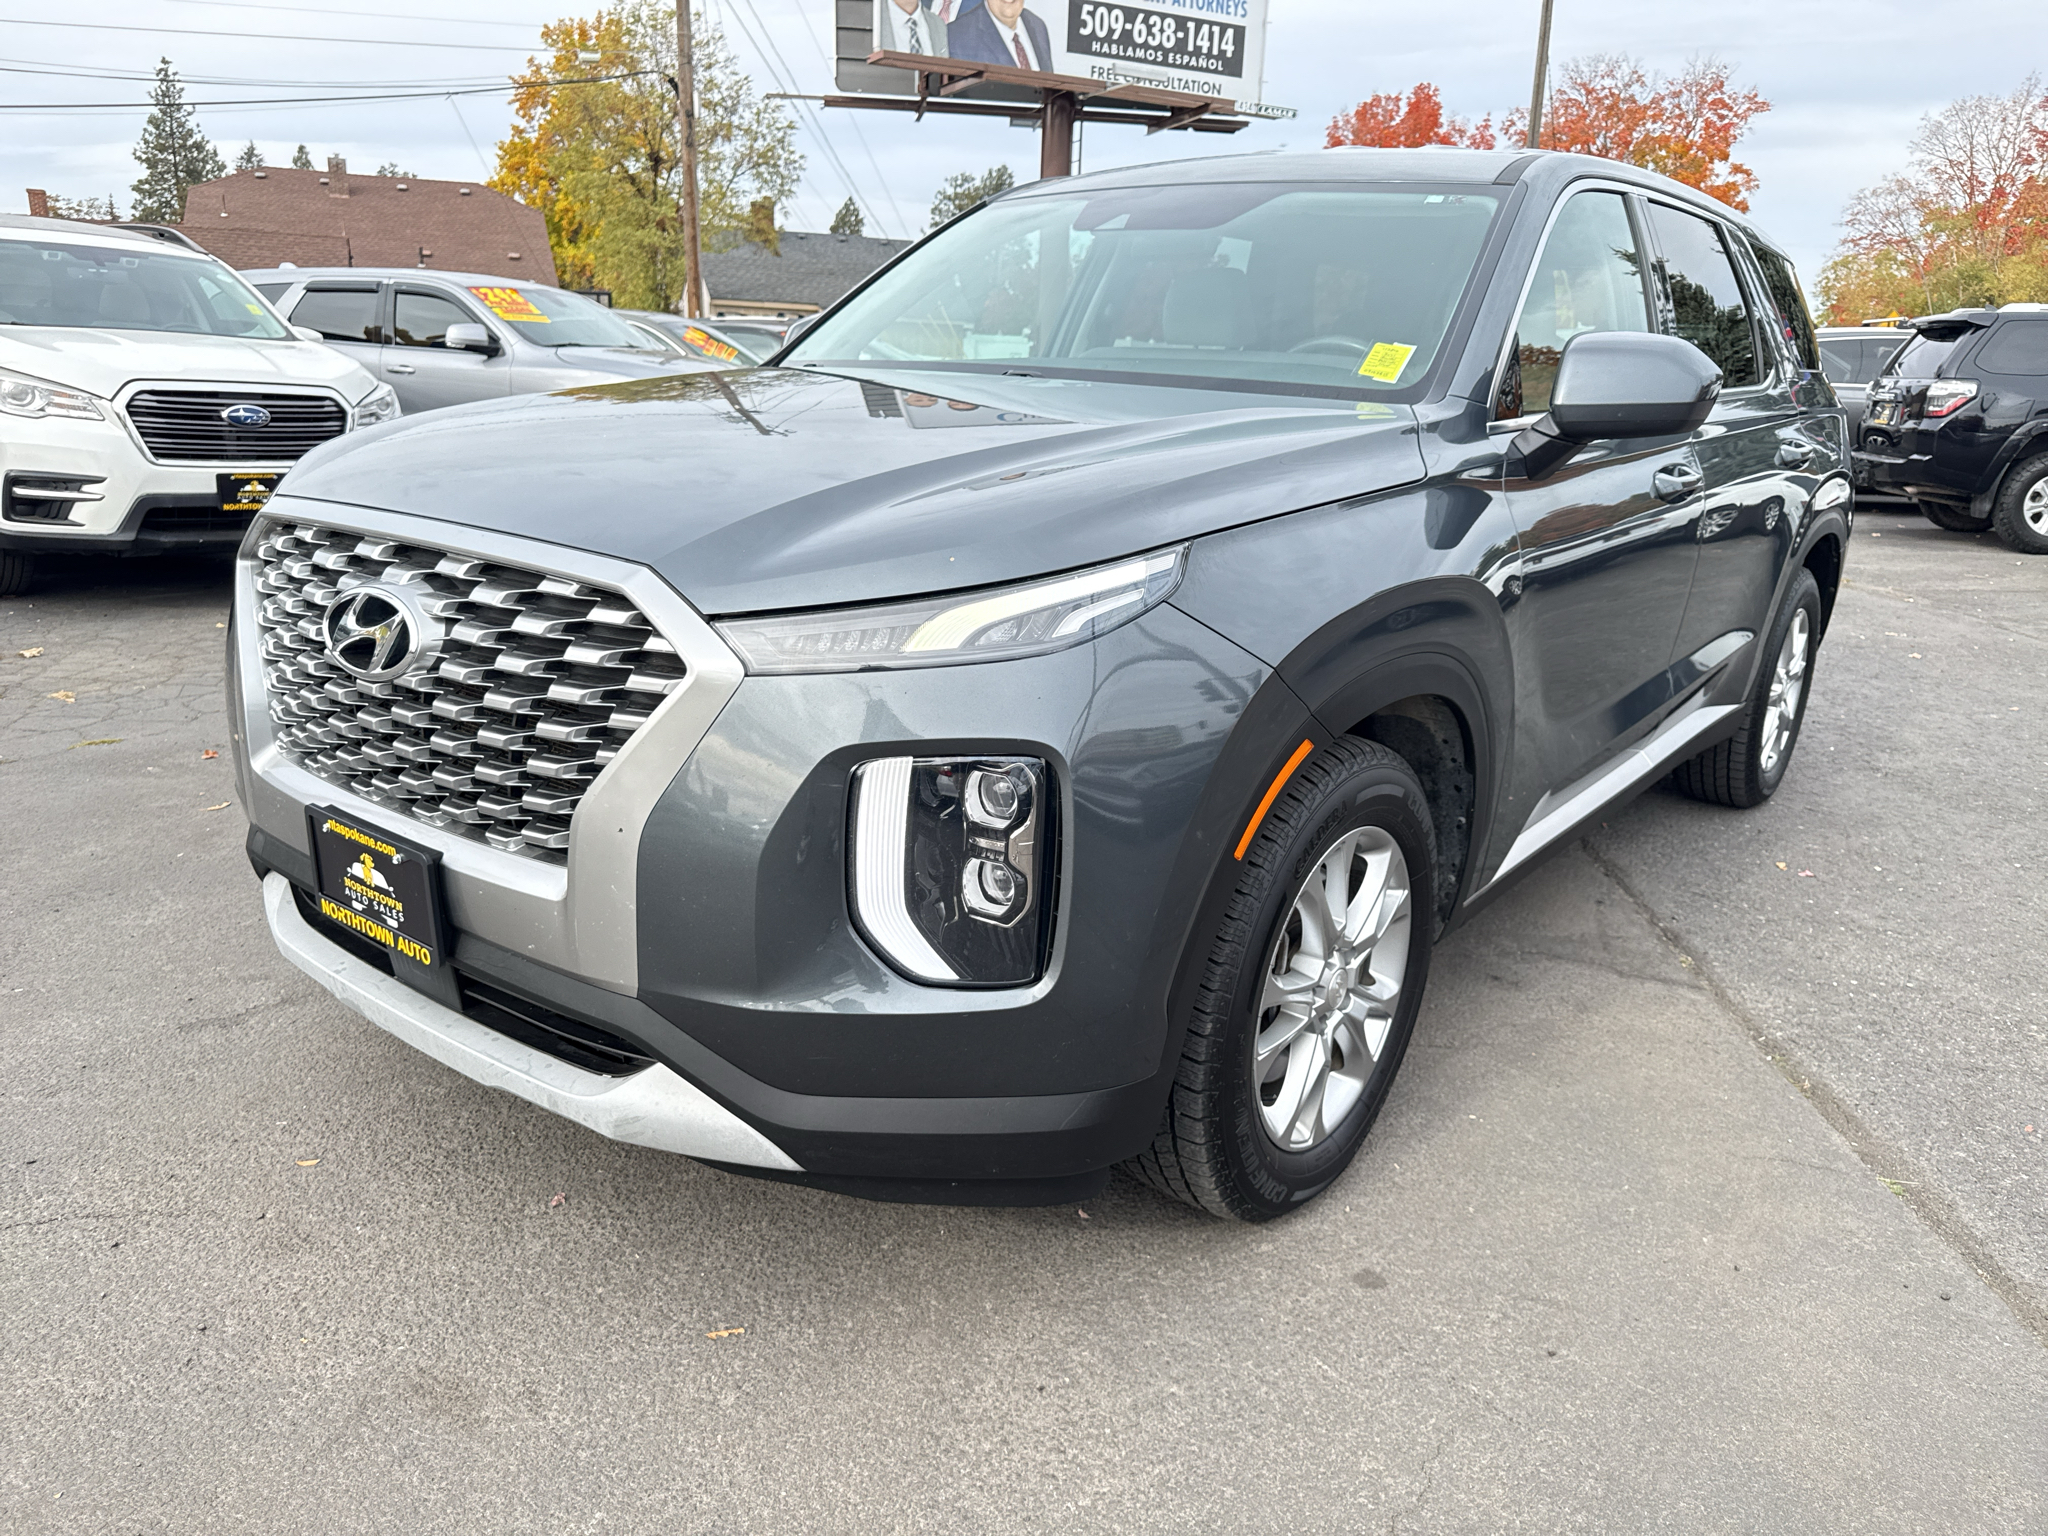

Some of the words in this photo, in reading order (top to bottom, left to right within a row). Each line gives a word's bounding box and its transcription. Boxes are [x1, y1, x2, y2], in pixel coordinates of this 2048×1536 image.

[1079, 3, 1235, 58] 509-638-1414
[1091, 41, 1164, 62] HABLAMOS
[1168, 53, 1224, 71] ESPAÑOL
[1124, 74, 1222, 96] CNSULTATION
[222, 503, 265, 511] NORTHTOW
[327, 819, 397, 857] ntaspokane.com
[344, 876, 403, 912] NORTHTOWN
[345, 887, 369, 905] AUTO
[373, 901, 405, 922] SALES
[321, 898, 395, 947] NORTHTOWN
[397, 937, 431, 965] AUTO
